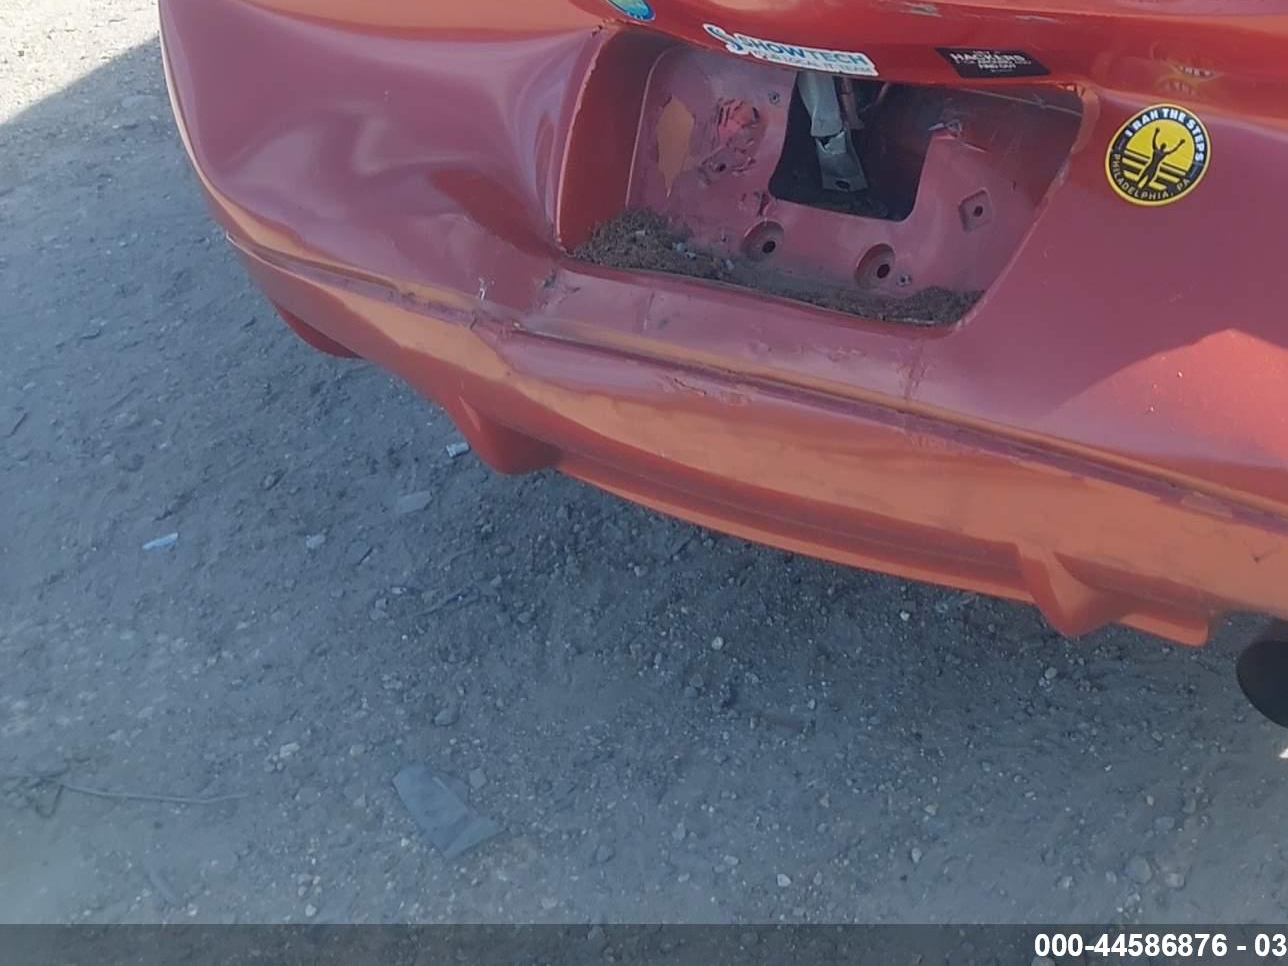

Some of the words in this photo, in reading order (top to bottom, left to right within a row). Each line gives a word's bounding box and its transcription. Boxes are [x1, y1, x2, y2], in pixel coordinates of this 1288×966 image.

[1131, 110, 1159, 130] RAN
[1162, 108, 1186, 123] THE
[1186, 118, 1206, 162] STEPS
[1176, 179, 1191, 191] PA
